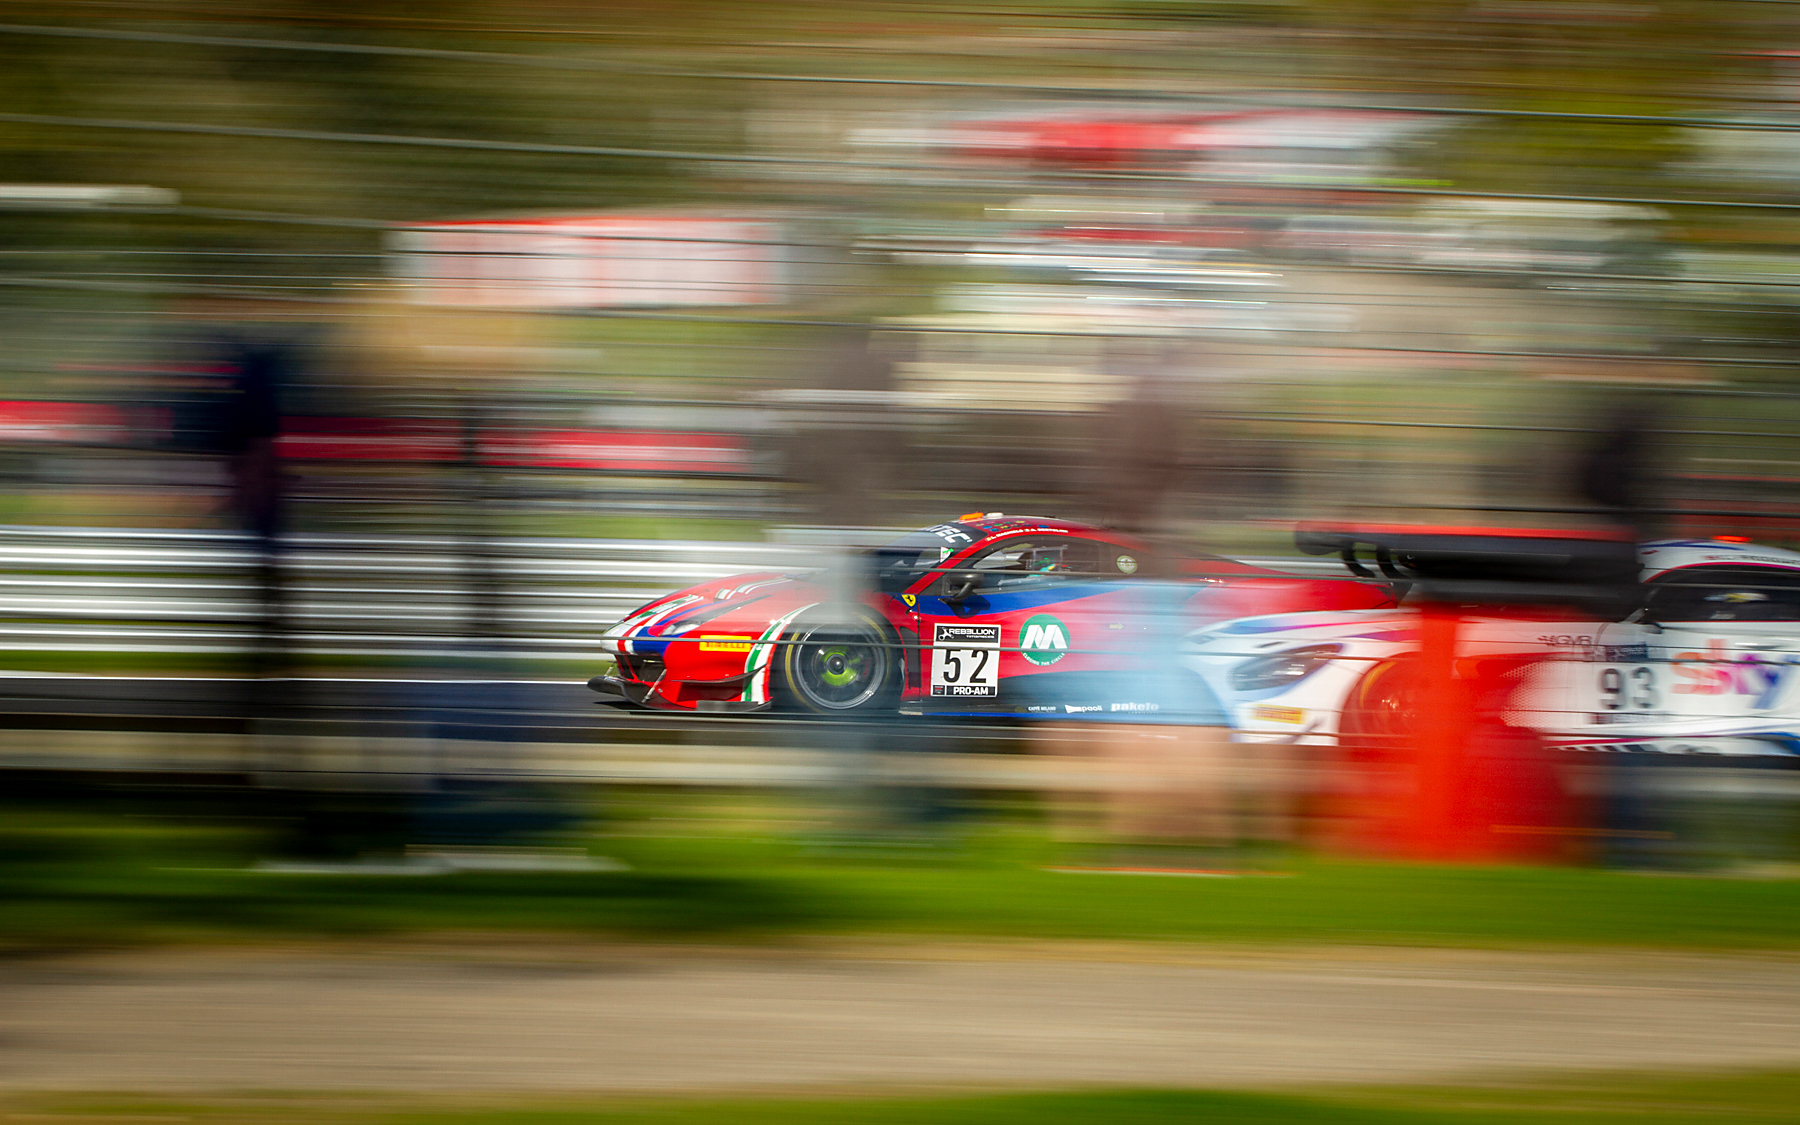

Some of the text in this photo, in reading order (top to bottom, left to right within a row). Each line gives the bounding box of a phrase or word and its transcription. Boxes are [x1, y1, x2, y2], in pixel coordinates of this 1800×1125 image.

[943, 648, 989, 684] 52
[953, 686, 988, 695] PRO-AM
[1599, 667, 1658, 710] 93
